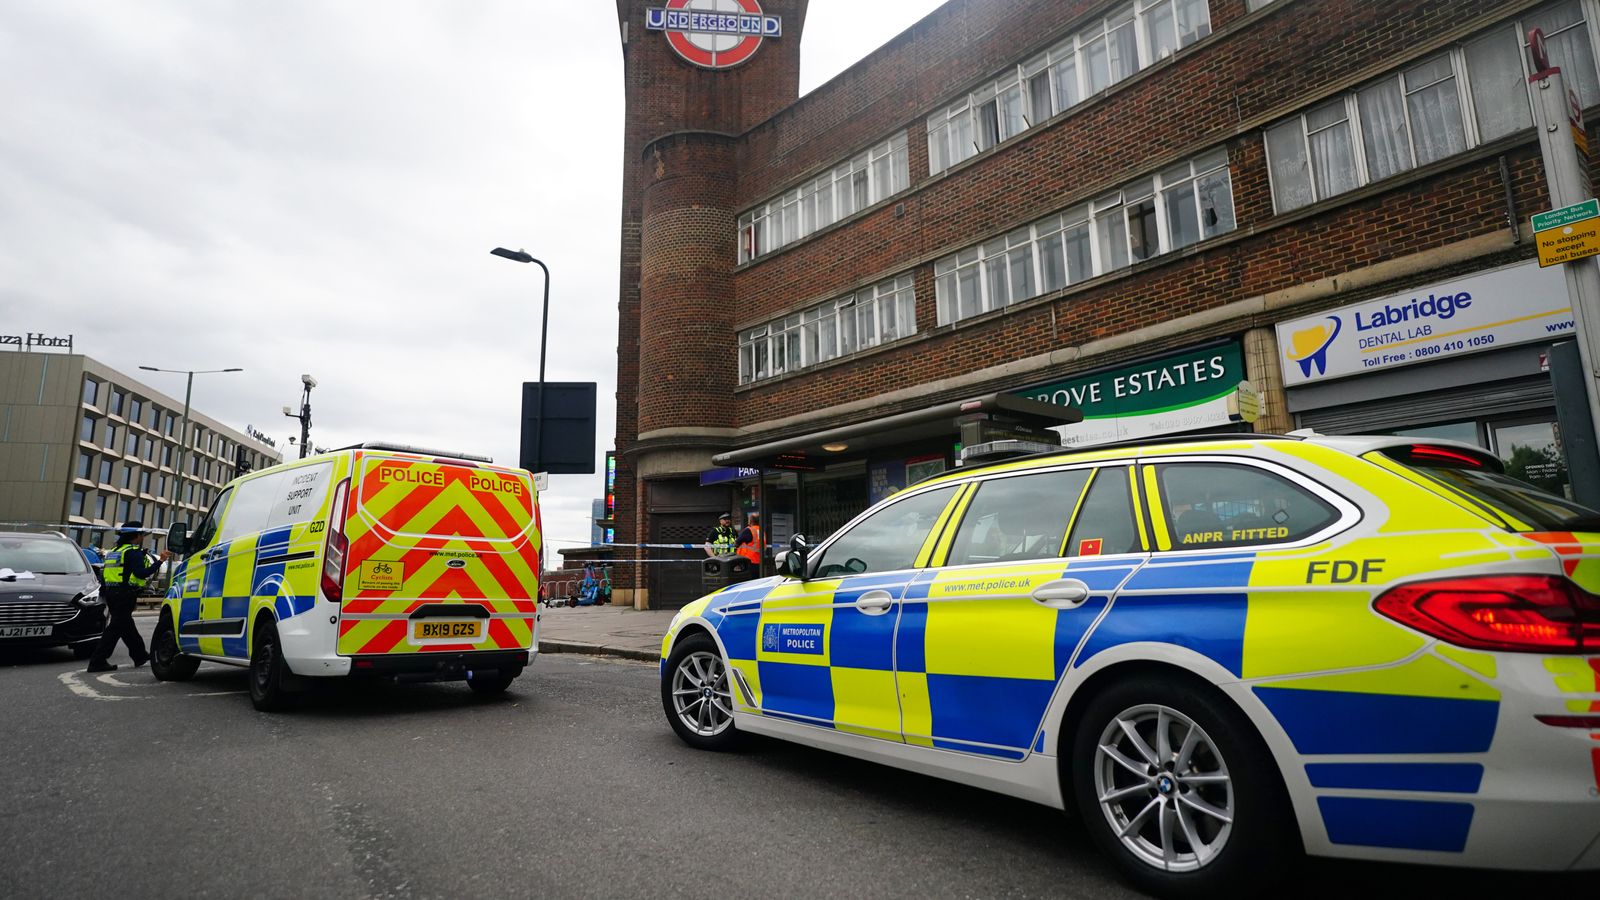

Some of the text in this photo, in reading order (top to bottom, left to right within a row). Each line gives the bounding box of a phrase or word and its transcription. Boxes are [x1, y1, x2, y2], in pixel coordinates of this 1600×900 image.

[648, 10, 779, 34] UNDERGROUND
[1537, 210, 1593, 228] Priority Network
[1545, 210, 1568, 220] London
[1557, 230, 1596, 245] stopping
[1556, 241, 1585, 253] except
[1546, 247, 1599, 263] local buses
[1355, 292, 1472, 331] Labridge
[0, 333, 73, 347] za Hotel
[1359, 325, 1433, 349] DENTAL LAB
[1362, 357, 1380, 368] Toll
[1383, 352, 1406, 364] Free
[1415, 344, 1441, 358] 0800
[1444, 341, 1464, 354] 410
[1467, 334, 1495, 349] 1050
[1114, 356, 1226, 398] ESTATES
[381, 468, 521, 494] POLICE POLICE
[287, 488, 312, 500] SUPPORT
[288, 505, 301, 515] UNIT
[310, 521, 325, 533] GZD
[1183, 527, 1289, 544] ANPR FITTED
[1306, 559, 1386, 584] FDF
[944, 578, 1031, 592] www.met.police.uk
[25, 627, 46, 636] FVX
[423, 623, 475, 636] BX19 GZS
[782, 628, 821, 636] METROPOLITAN
[787, 639, 815, 649] POLICE
